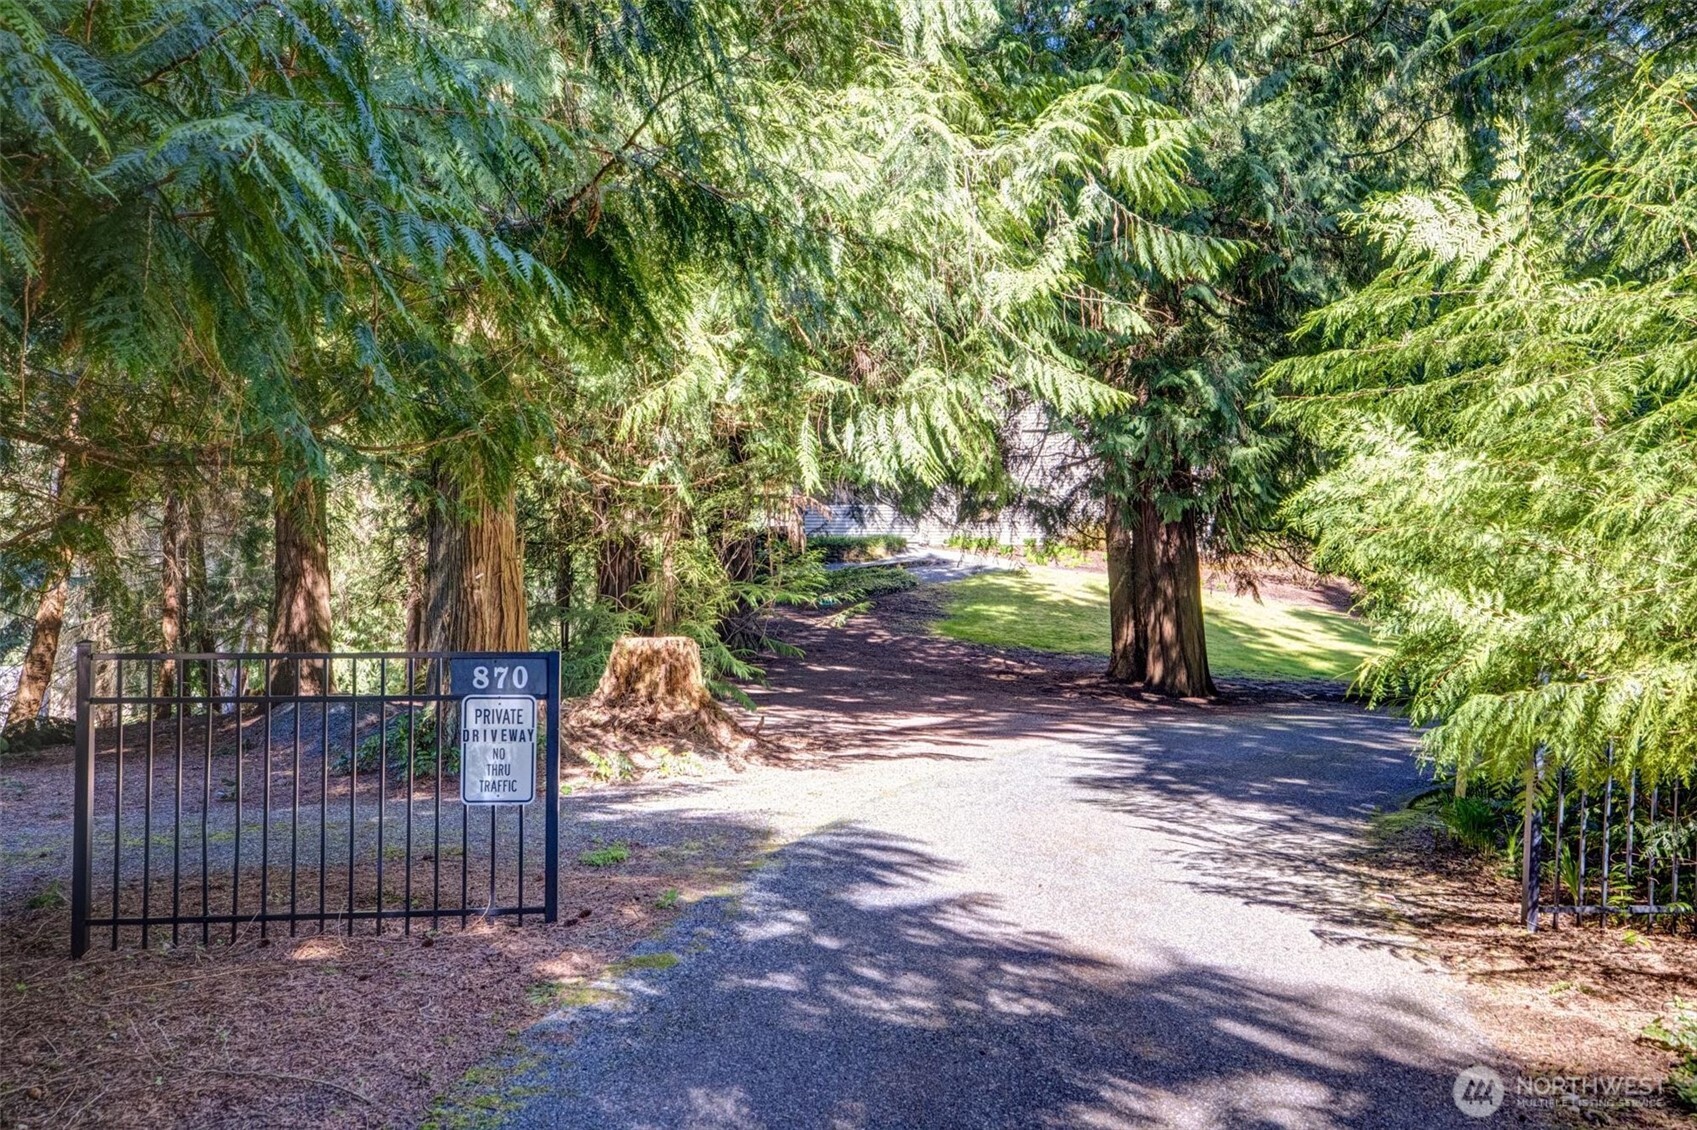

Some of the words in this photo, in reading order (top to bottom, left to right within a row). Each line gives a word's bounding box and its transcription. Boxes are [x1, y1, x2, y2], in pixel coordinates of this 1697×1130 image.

[472, 666, 528, 689] 870
[475, 709, 523, 724] PRIVATE
[463, 729, 534, 742] DRIVEWAY
[493, 748, 505, 760] NO
[487, 764, 510, 776] THRU
[479, 779, 517, 792] TRAFFIC
